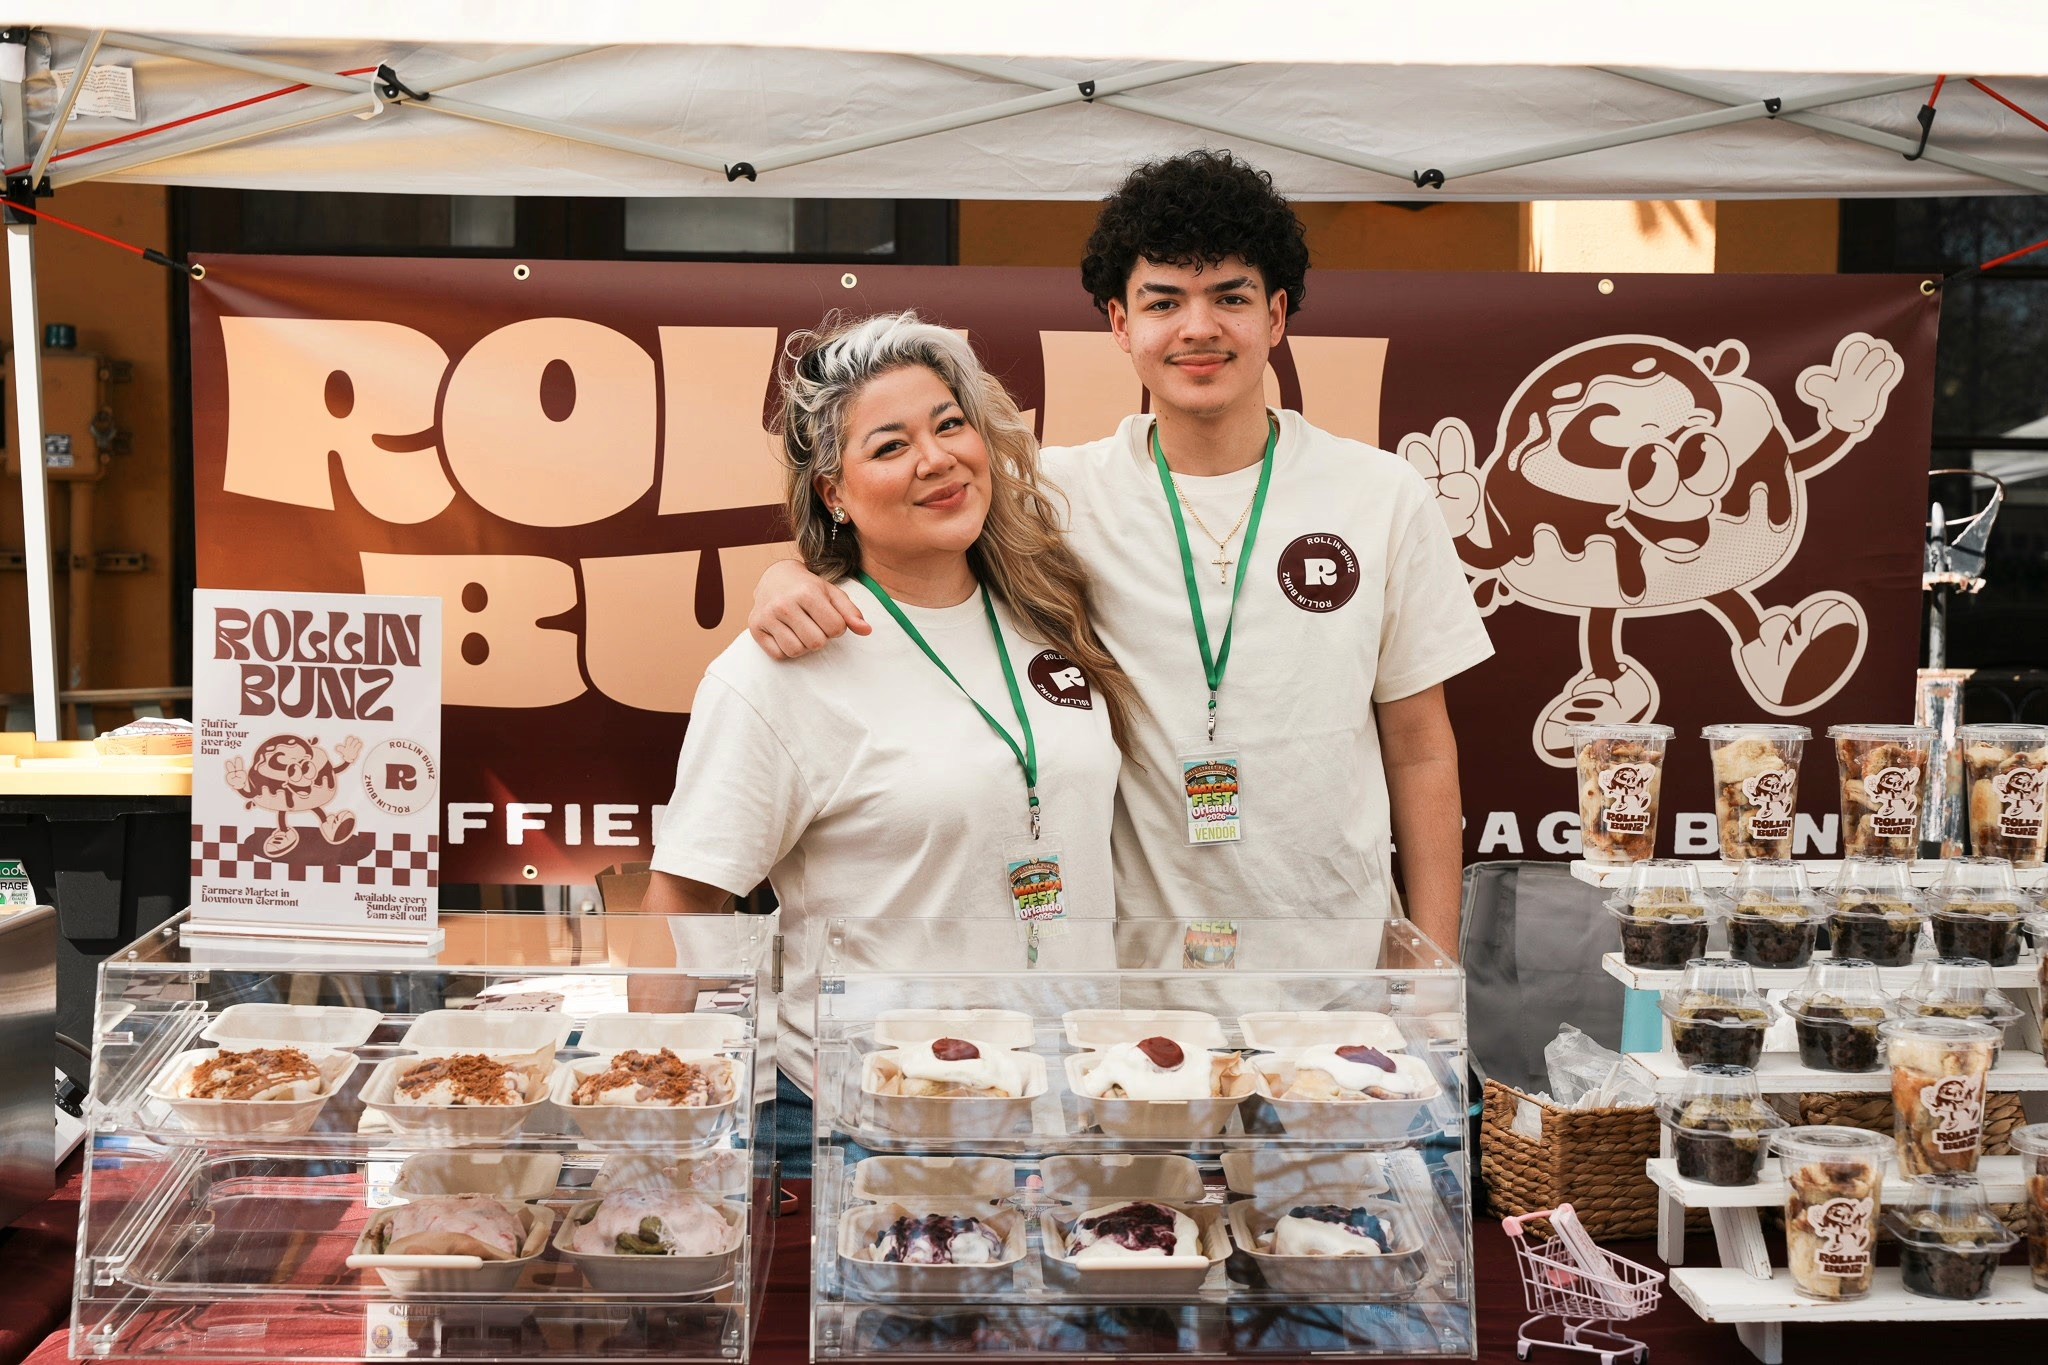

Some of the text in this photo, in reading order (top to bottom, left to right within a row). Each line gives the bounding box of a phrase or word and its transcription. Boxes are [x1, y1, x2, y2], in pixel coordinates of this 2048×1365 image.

[1307, 536, 1355, 573] ROLLIN BUNZ
[1304, 558, 1337, 586] R
[1282, 571, 1332, 608] ROLLIN BUNZ
[214, 607, 422, 667] ROLLIN
[359, 548, 798, 714] BU
[1049, 666, 1085, 691] R
[239, 664, 393, 721] BUNZ
[1037, 683, 1059, 702] BUNZ
[201, 719, 238, 729] Fluffier
[201, 728, 249, 740] than your
[201, 739, 242, 749] average
[201, 746, 220, 755] bun
[389, 741, 435, 779] ROLLIN BUNZ
[385, 763, 417, 791] R
[364, 775, 410, 813] ROLLIN BUNZ
[1192, 791, 1234, 807] FEST
[1192, 803, 1237, 819] Orlando
[1207, 813, 1226, 822] 2026
[1606, 811, 1648, 823] ROLLIN
[1610, 822, 1644, 832] BUNZ
[1752, 819, 1791, 828] ROLLIN
[1873, 817, 1915, 826] ROLLIN
[2000, 817, 2042, 827] ROLLIN
[448, 802, 669, 846] FFIE
[1674, 812, 1839, 855] BN
[1195, 826, 1236, 841] VENDOR
[1756, 828, 1788, 837] BUNZ
[1878, 826, 1911, 835] BUNZ
[2005, 827, 2038, 836] BUNZ
[202, 885, 290, 897] Farmers Market in
[201, 894, 299, 907] Downtown Clermont
[354, 892, 427, 906] Available every
[1019, 889, 1059, 909] FEST
[366, 902, 427, 912] Sunday from
[366, 910, 427, 921] 9am sell out!
[1034, 913, 1053, 921] 2026
[1936, 1127, 1980, 1142] ROLLIN
[1818, 1252, 1868, 1264] ROLLIN
